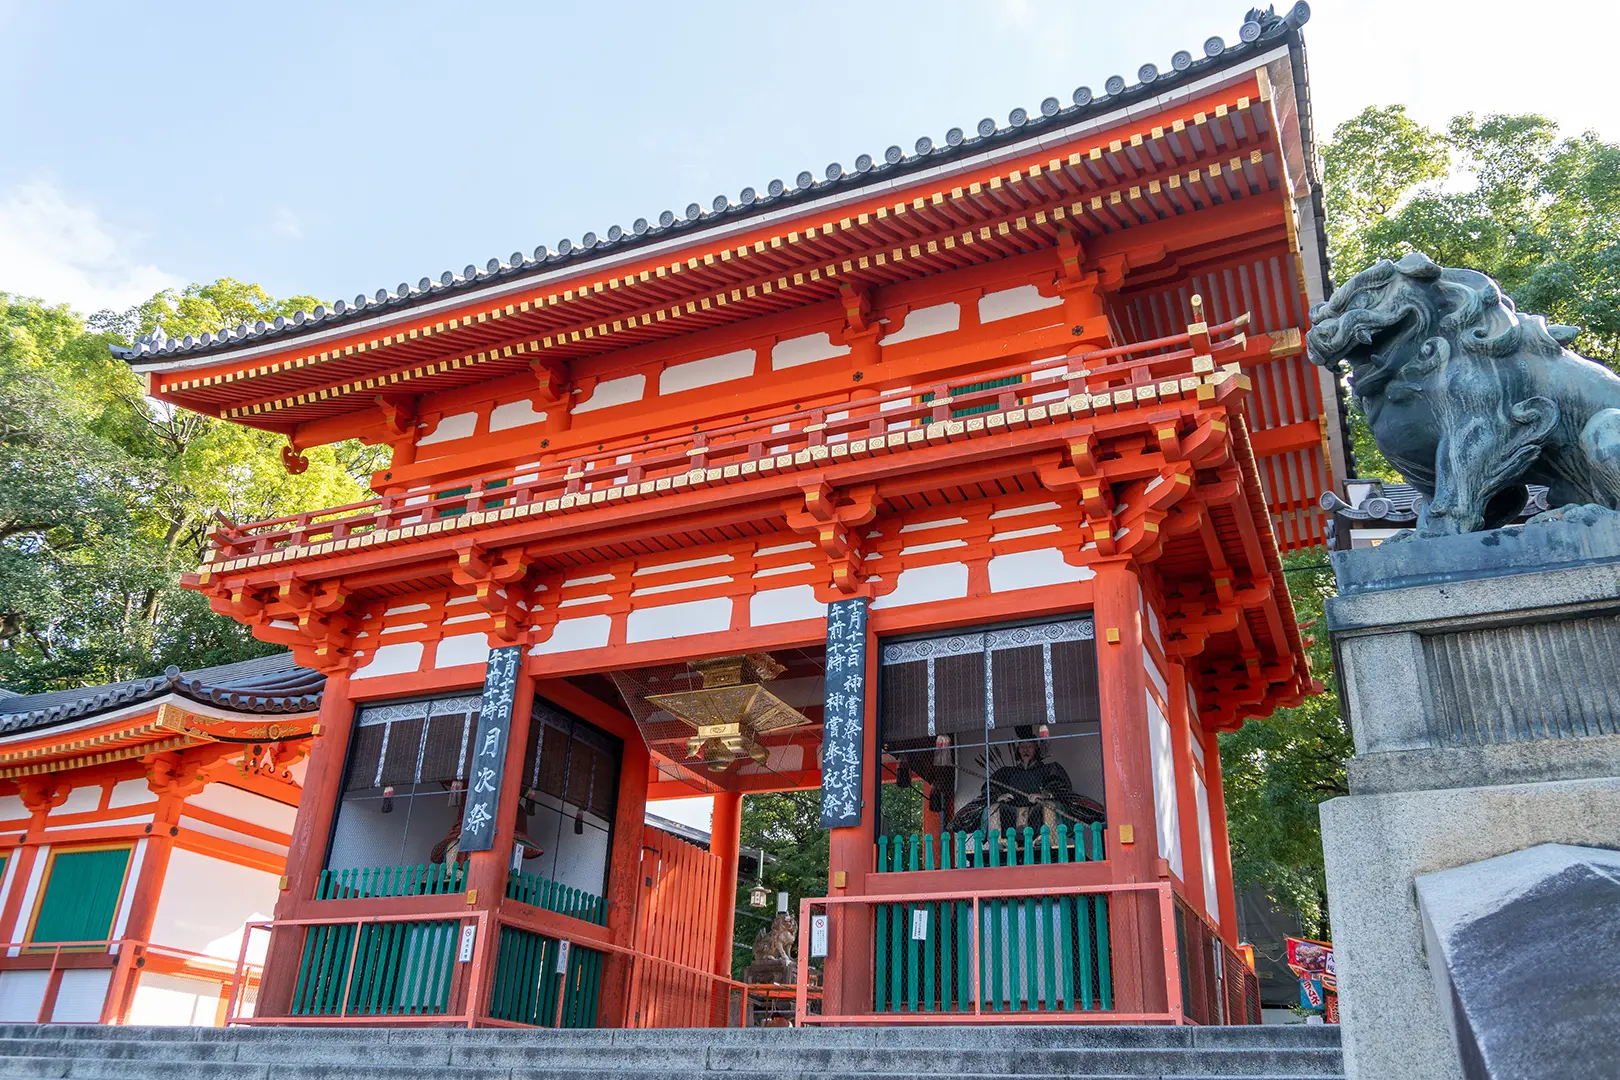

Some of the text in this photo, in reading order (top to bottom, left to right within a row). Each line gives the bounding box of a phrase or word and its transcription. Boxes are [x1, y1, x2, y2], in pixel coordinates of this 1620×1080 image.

[827, 603, 846, 672] 午前十時
[844, 600, 864, 667] 十月十七日
[480, 649, 503, 720] 午前十時
[496, 649, 519, 718] 十月十五日
[465, 727, 501, 835] 月次祭
[1304, 981, 1320, 1005] ラムネ
